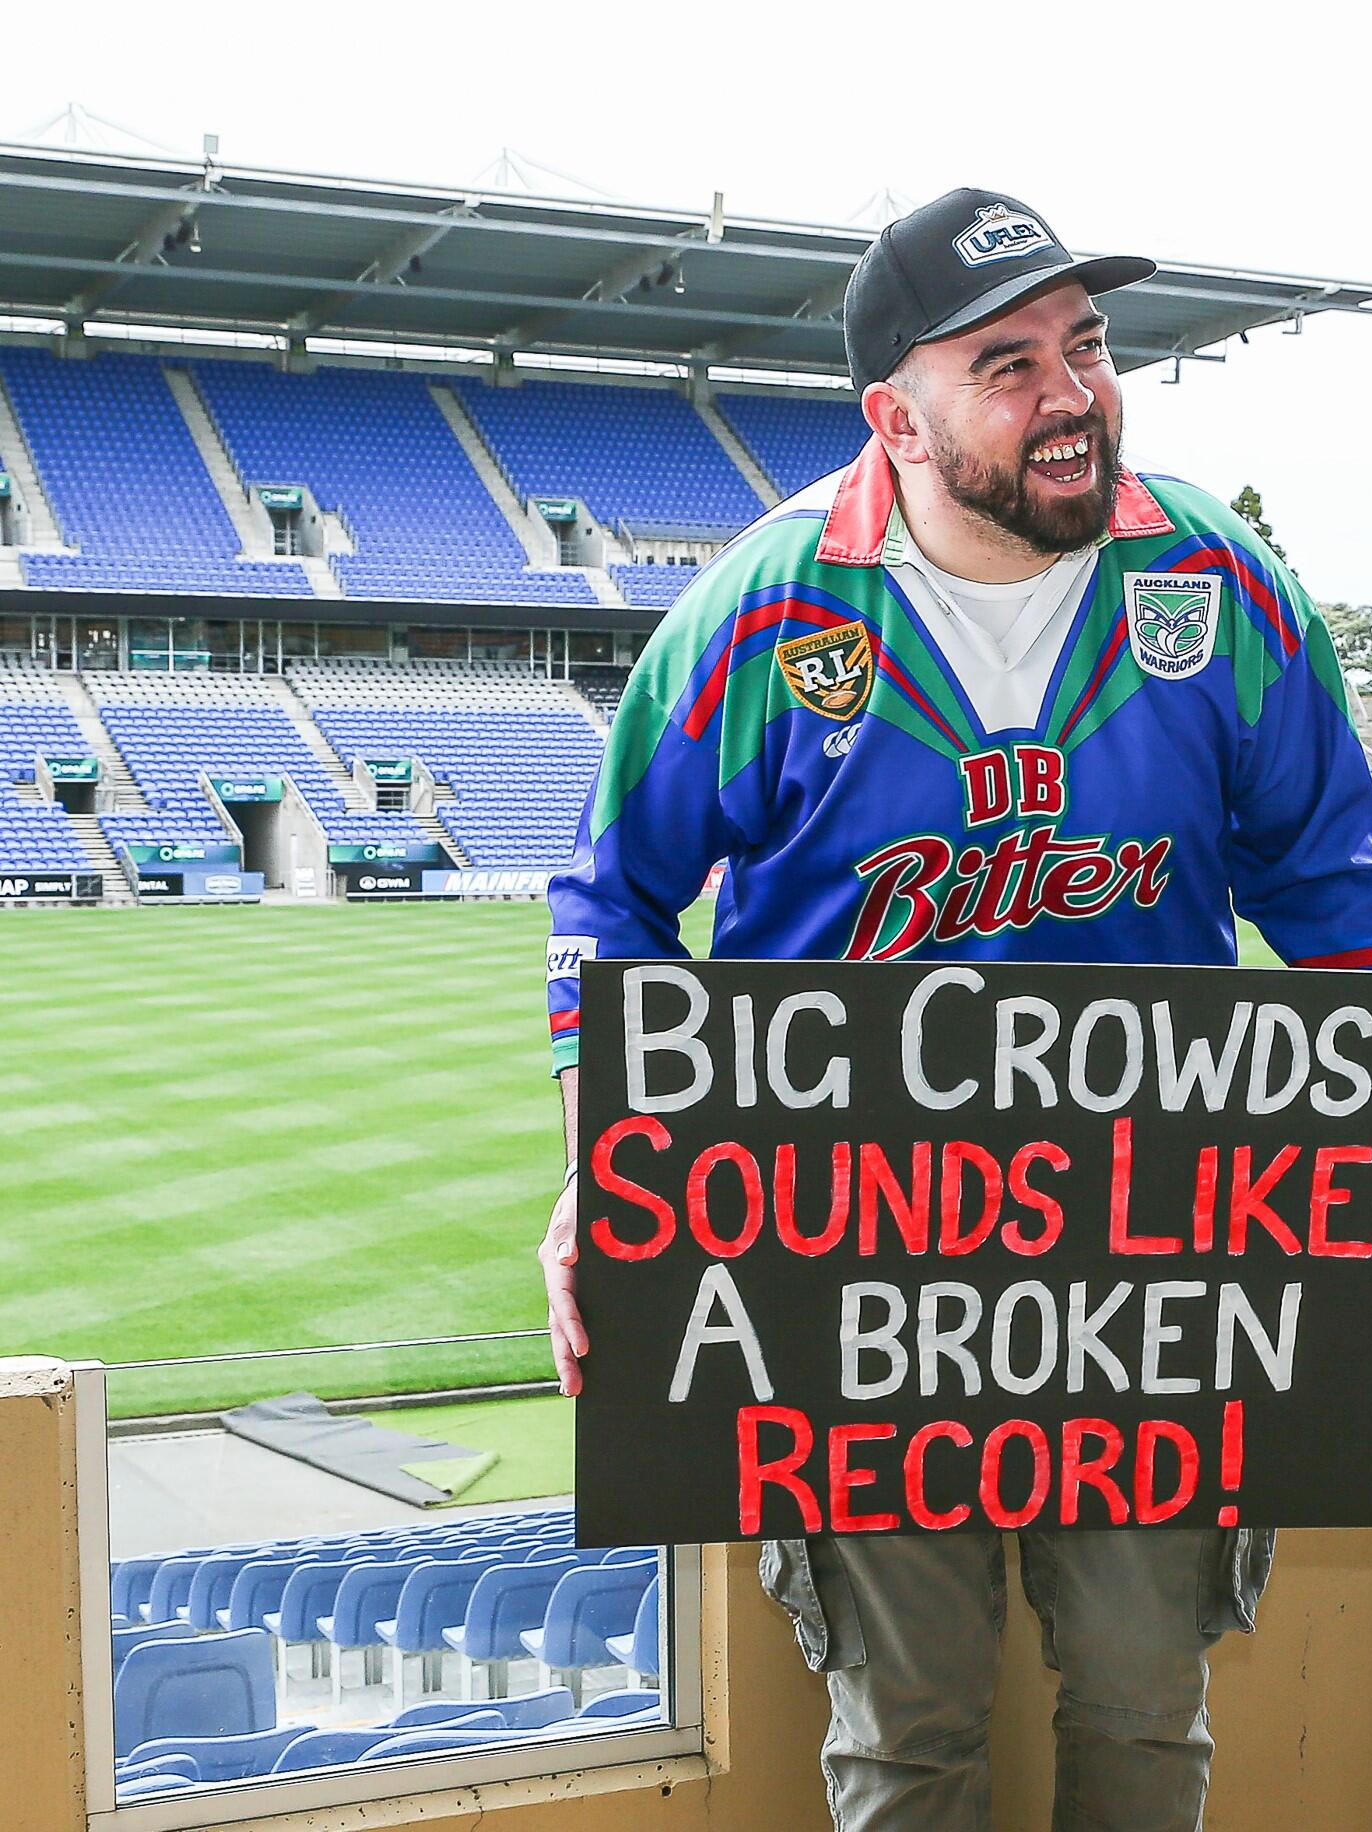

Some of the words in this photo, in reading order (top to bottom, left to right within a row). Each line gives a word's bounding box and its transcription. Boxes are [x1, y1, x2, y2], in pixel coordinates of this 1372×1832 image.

[970, 223, 1041, 253] UFLEX
[1133, 578, 1211, 589] AUCKLAND
[782, 628, 859, 658] AUSTRALIAN
[795, 648, 862, 693] RL
[1139, 646, 1204, 673] WARRIORS
[960, 744, 1066, 828] DB
[840, 824, 1173, 960] Bitter
[623, 964, 852, 1115] BIG
[590, 1114, 1070, 1263] SOUNDS
[668, 1263, 774, 1403] A
[840, 1279, 1303, 1400] BROKEN
[739, 1400, 1244, 1536] RECORD!
